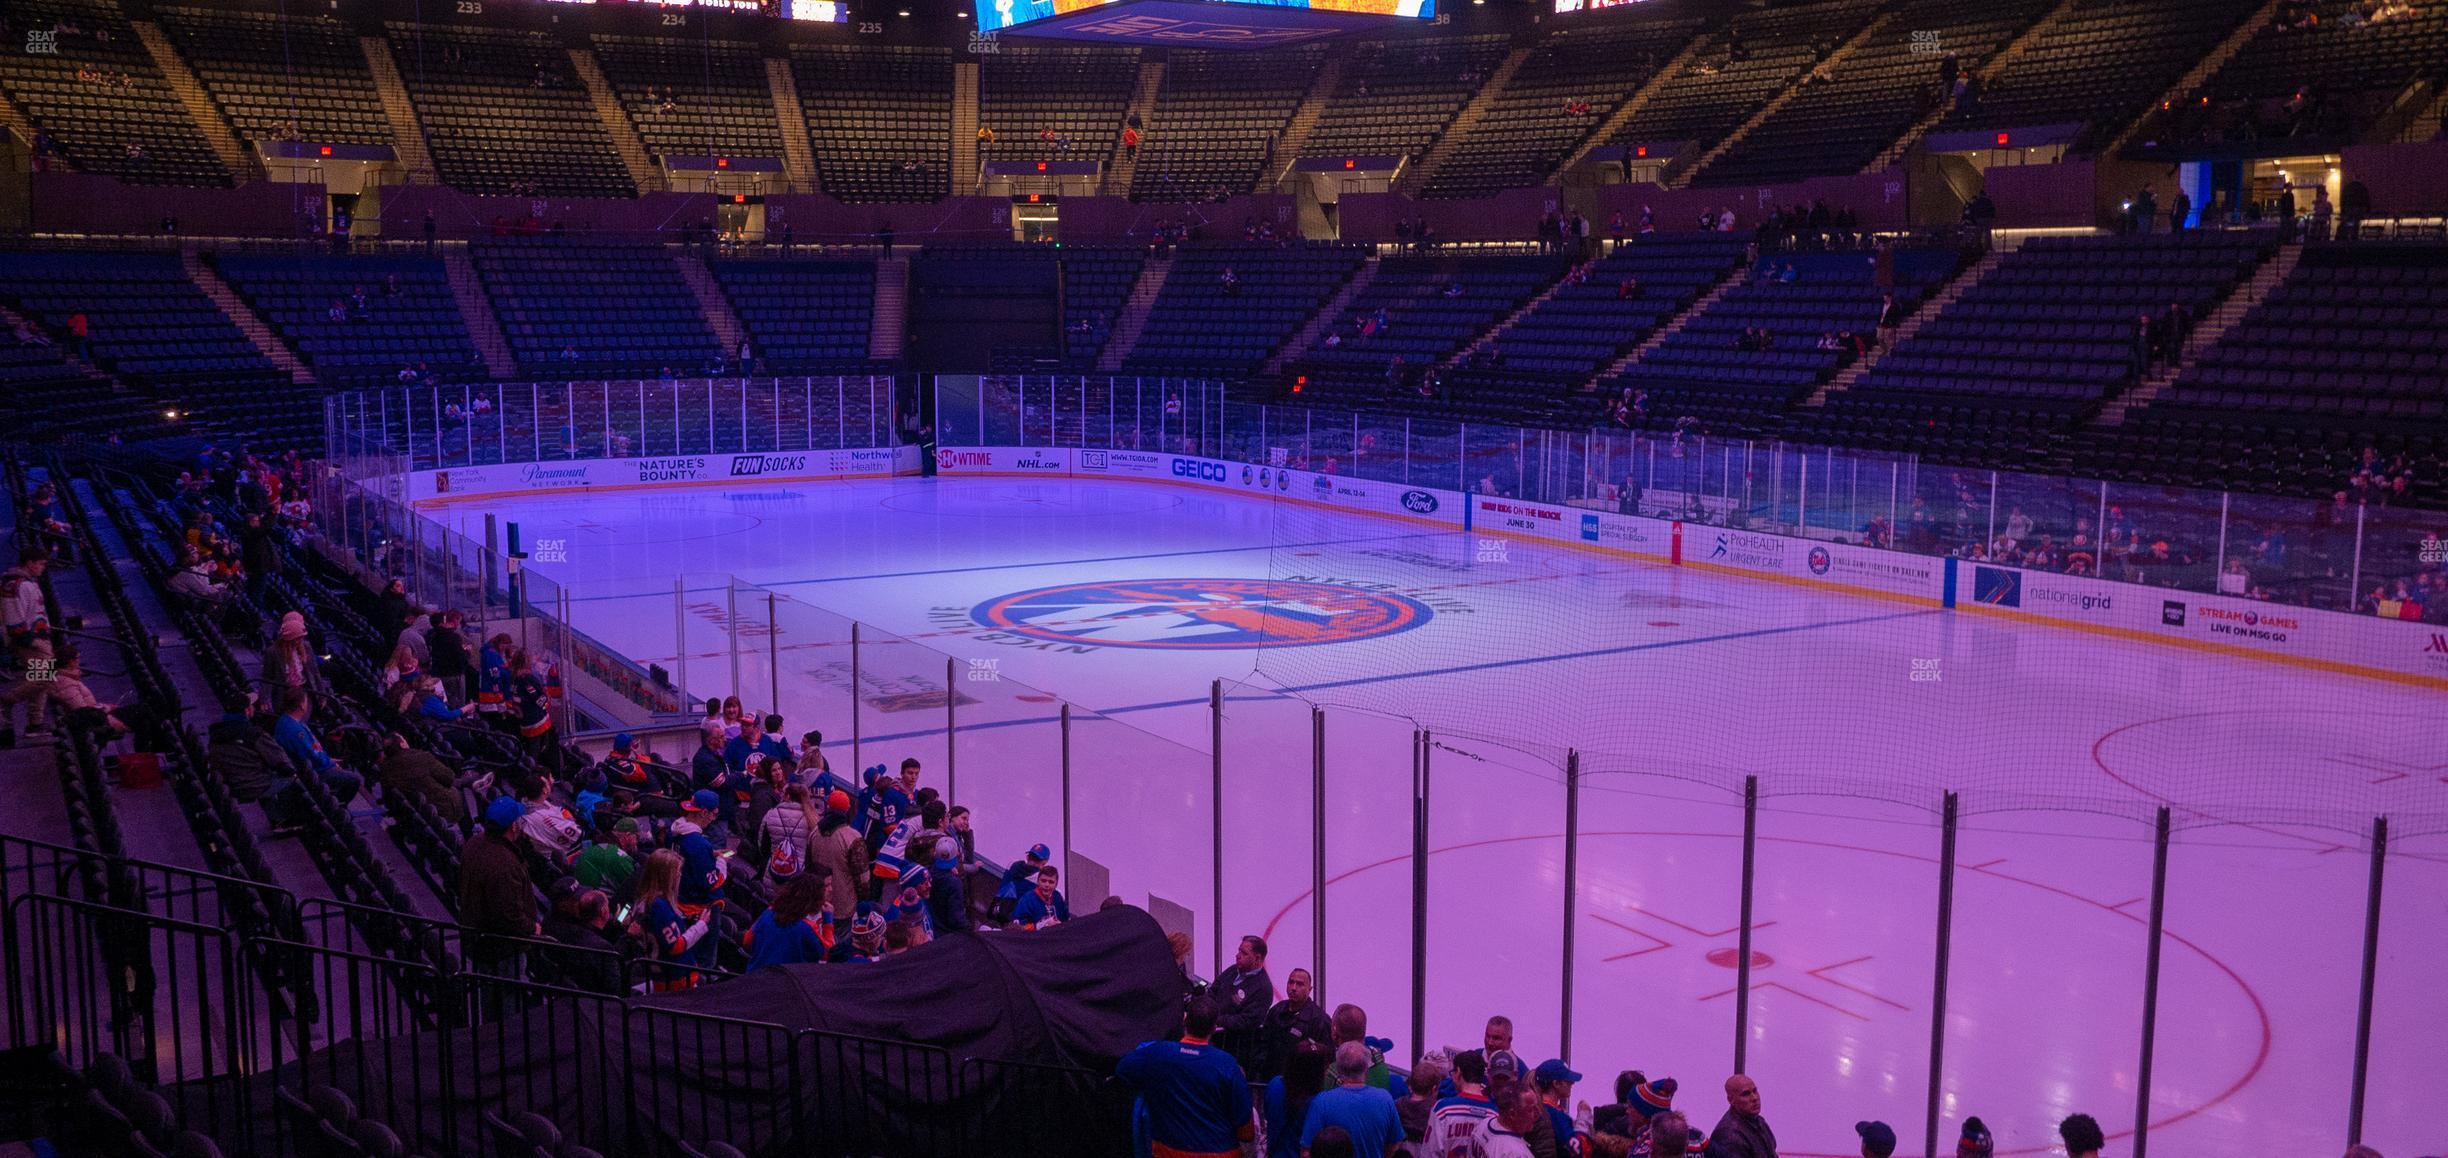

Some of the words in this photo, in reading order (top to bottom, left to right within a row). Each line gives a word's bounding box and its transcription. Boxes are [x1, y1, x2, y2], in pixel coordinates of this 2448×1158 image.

[457, 1, 482, 14] 233
[662, 14, 687, 26] 234
[859, 22, 882, 33] 235
[639, 458, 705, 471] NATURE'S
[732, 456, 764, 474] FUN
[763, 456, 806, 472] SOCKS
[938, 449, 992, 469] SHOWTIME
[520, 464, 590, 483] Paramount
[851, 462, 883, 473] Health
[1172, 458, 1226, 482] GEICO
[640, 470, 696, 482] BOUNTY
[1406, 491, 1433, 512] Ford
[1513, 506, 1523, 516] ON
[1525, 508, 1537, 517] THE
[1506, 518, 1525, 528] JUNE
[1525, 520, 1535, 530] 30
[1730, 552, 1762, 566] URGENT
[1762, 556, 1783, 569] CARE
[2199, 606, 2242, 622] STREAM
[2260, 616, 2299, 630] GAMES
[2211, 623, 2231, 635] LIVE
[2234, 626, 2247, 637] ON
[2249, 629, 2270, 641] MSG
[2273, 632, 2287, 643] GO
[883, 804, 896, 817] 13
